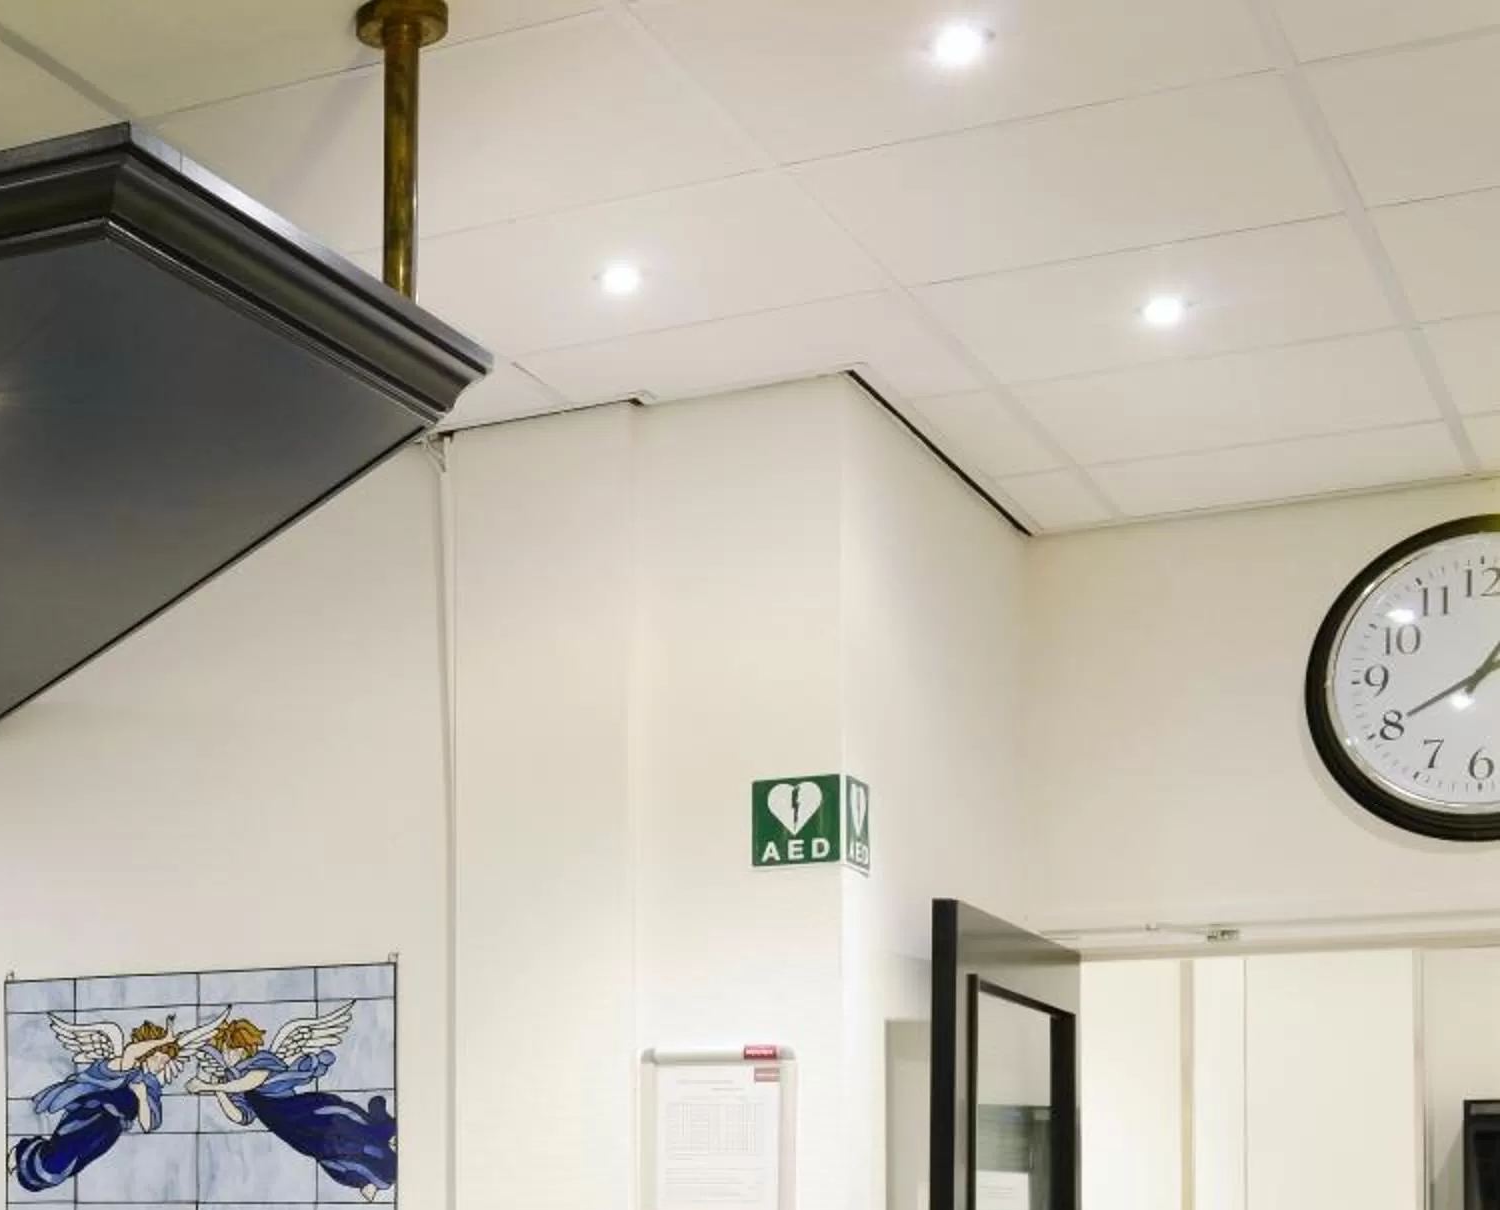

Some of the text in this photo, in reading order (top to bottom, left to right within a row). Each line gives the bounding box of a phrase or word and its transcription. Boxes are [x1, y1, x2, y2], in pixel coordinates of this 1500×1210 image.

[1466, 566, 1500, 598] 12
[1421, 586, 1449, 617] 11
[1383, 623, 1421, 656] 10
[1363, 664, 1389, 697] 9
[1379, 709, 1404, 741] 8
[1422, 738, 1444, 770] 7
[1467, 748, 1495, 781] 6
[761, 837, 830, 863] AED
